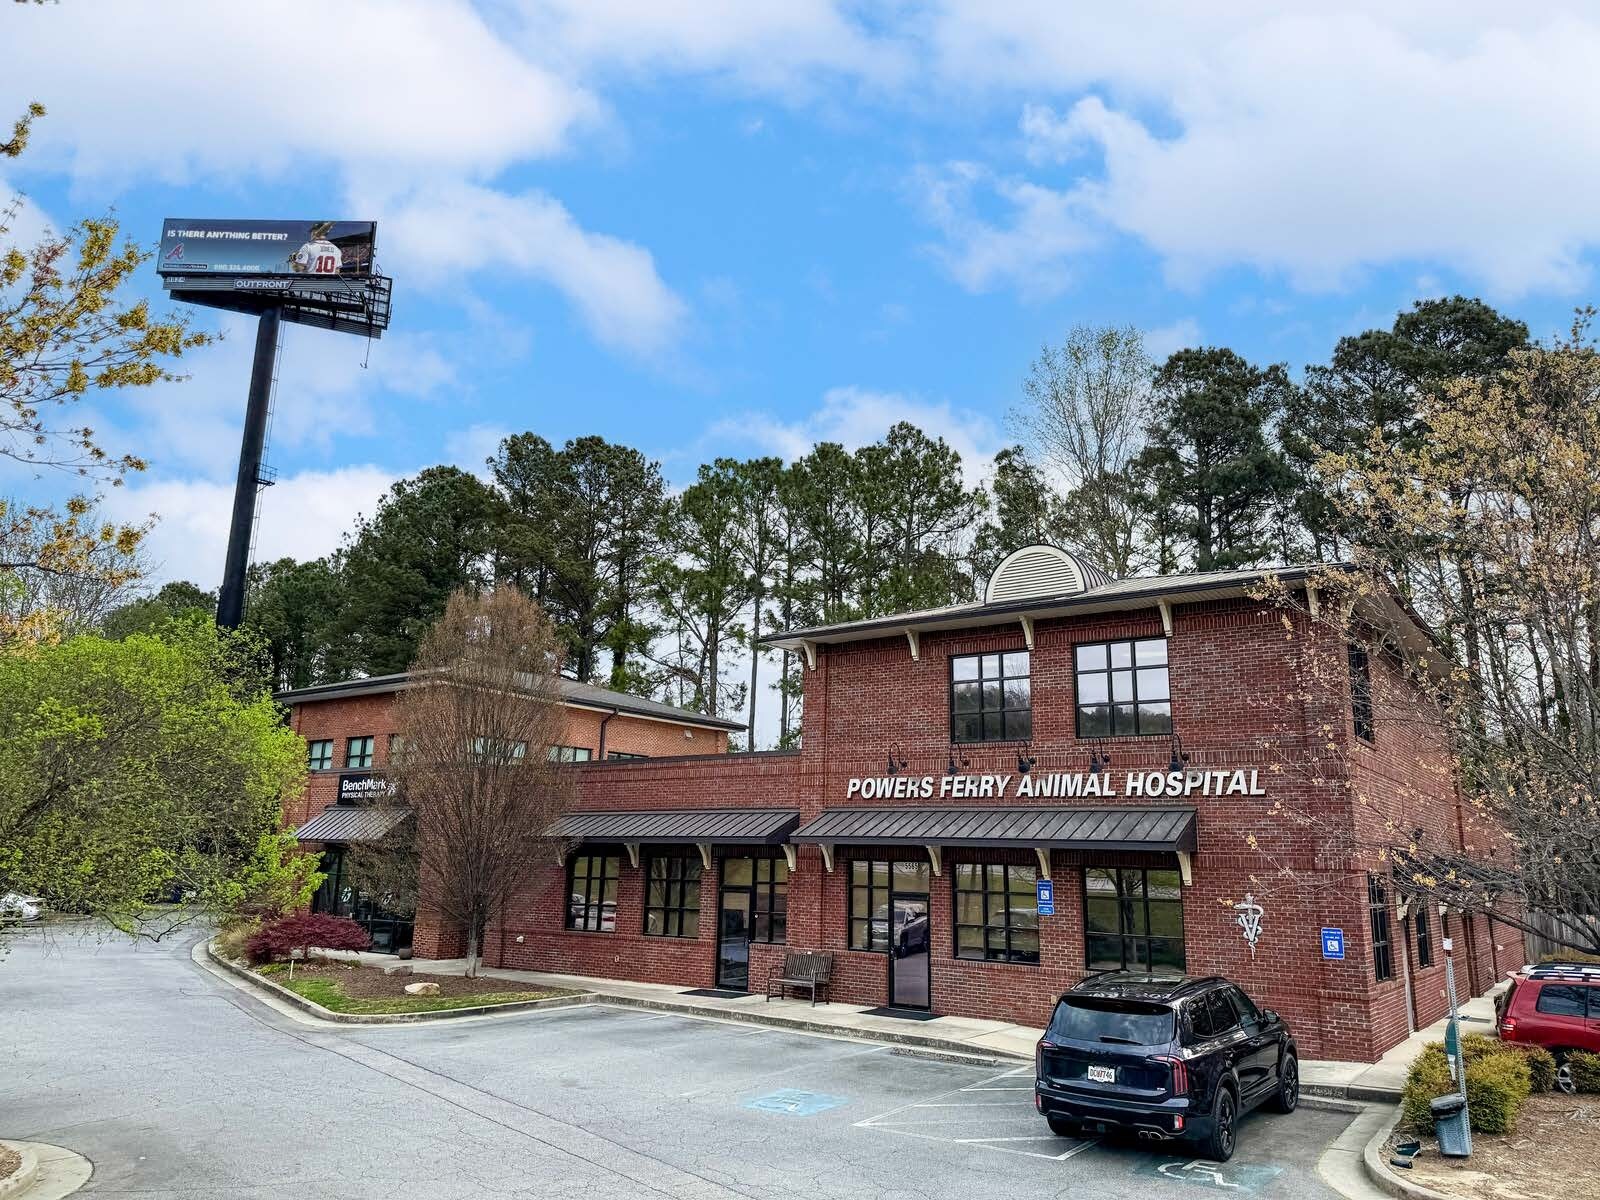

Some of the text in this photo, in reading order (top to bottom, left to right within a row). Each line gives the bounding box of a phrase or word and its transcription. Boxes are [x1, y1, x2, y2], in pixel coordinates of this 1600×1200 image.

[167, 230, 288, 241] IS THERE ANYTHING BETTER?
[316, 255, 336, 273] 10
[236, 280, 289, 289] OUTFRONT
[342, 778, 387, 791] BenchMark
[846, 769, 1267, 799] POWERS FERRY ANIMAL HOSPITAL
[341, 790, 386, 799] PHYSICAL THERAPY
